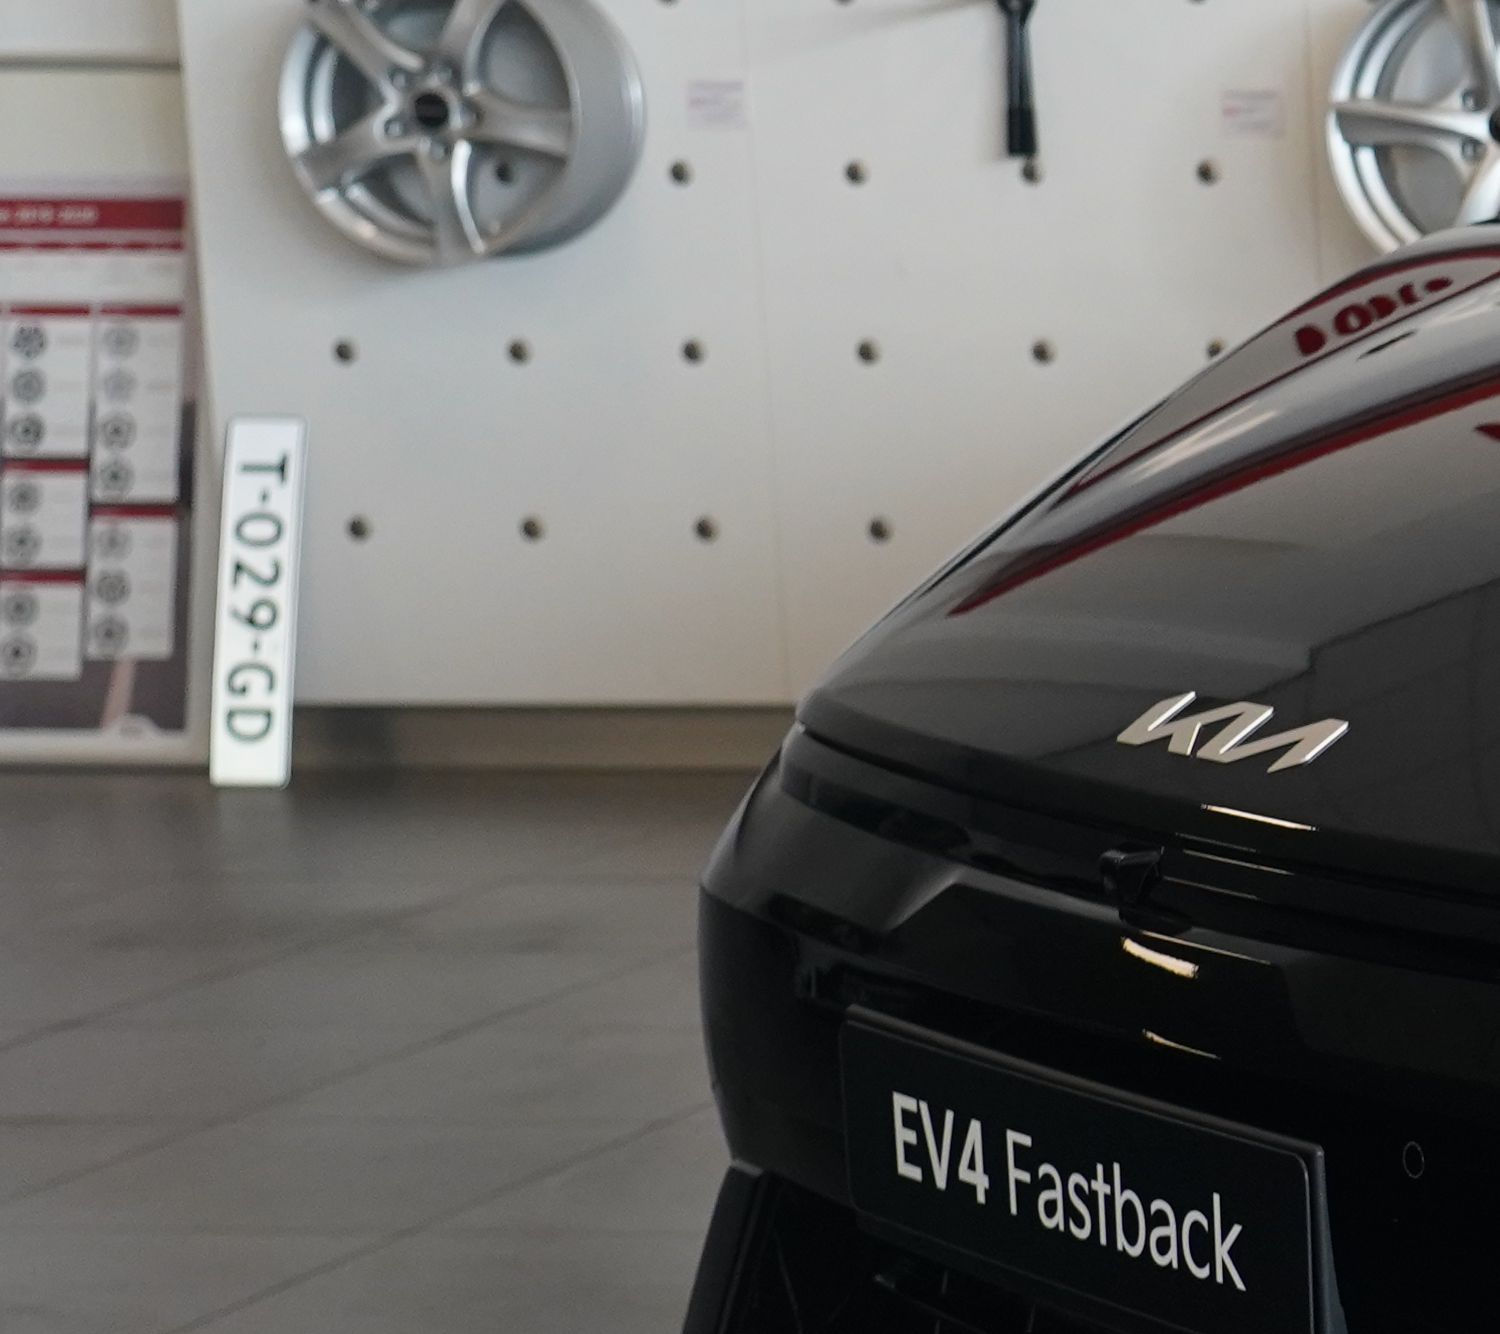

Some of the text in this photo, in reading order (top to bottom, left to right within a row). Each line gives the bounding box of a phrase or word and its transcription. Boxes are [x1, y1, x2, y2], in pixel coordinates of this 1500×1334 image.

[226, 452, 289, 744] T-029-GD
[892, 1090, 1247, 1292] EV4 Fastback
